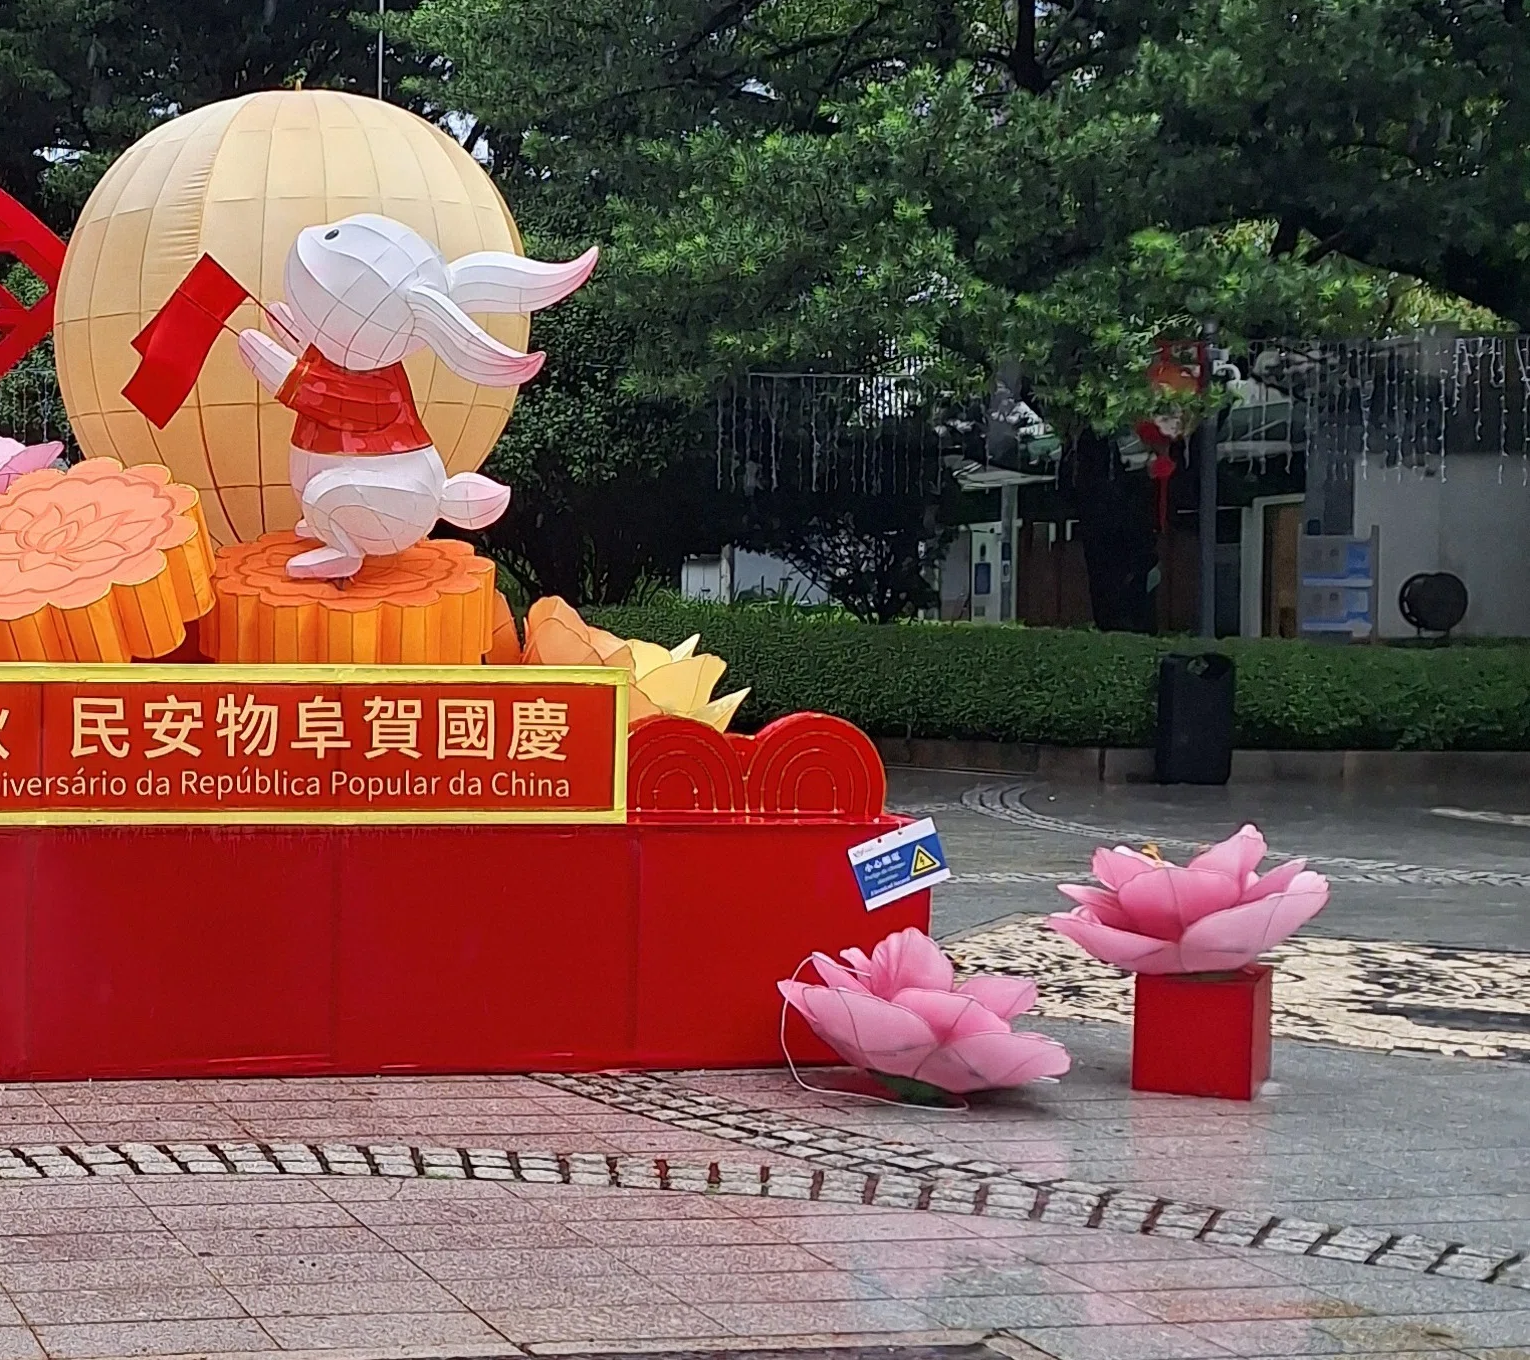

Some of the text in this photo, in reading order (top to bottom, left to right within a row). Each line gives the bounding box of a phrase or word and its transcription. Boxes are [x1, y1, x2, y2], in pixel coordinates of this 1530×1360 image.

[69, 693, 571, 762] 民安物阜賀國慶
[136, 769, 170, 796] da
[181, 766, 320, 801] República
[331, 770, 441, 802] Popular
[449, 769, 482, 796] da
[491, 770, 570, 798] China
